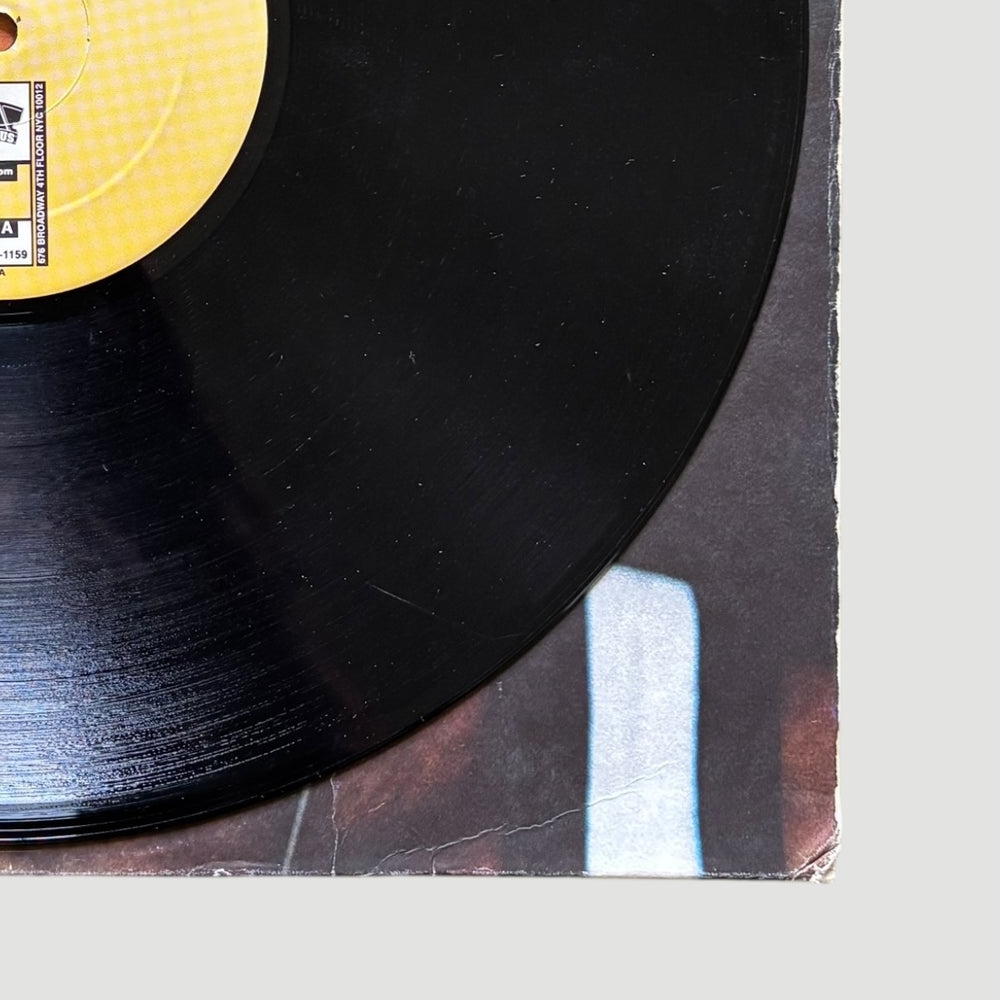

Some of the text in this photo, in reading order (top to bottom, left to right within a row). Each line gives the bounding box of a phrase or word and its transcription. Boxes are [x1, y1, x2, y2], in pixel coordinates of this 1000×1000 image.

[34, 83, 46, 264] 676 BROADWAY 4TH FLOOR NYC 10012
[1, 220, 13, 234] A
